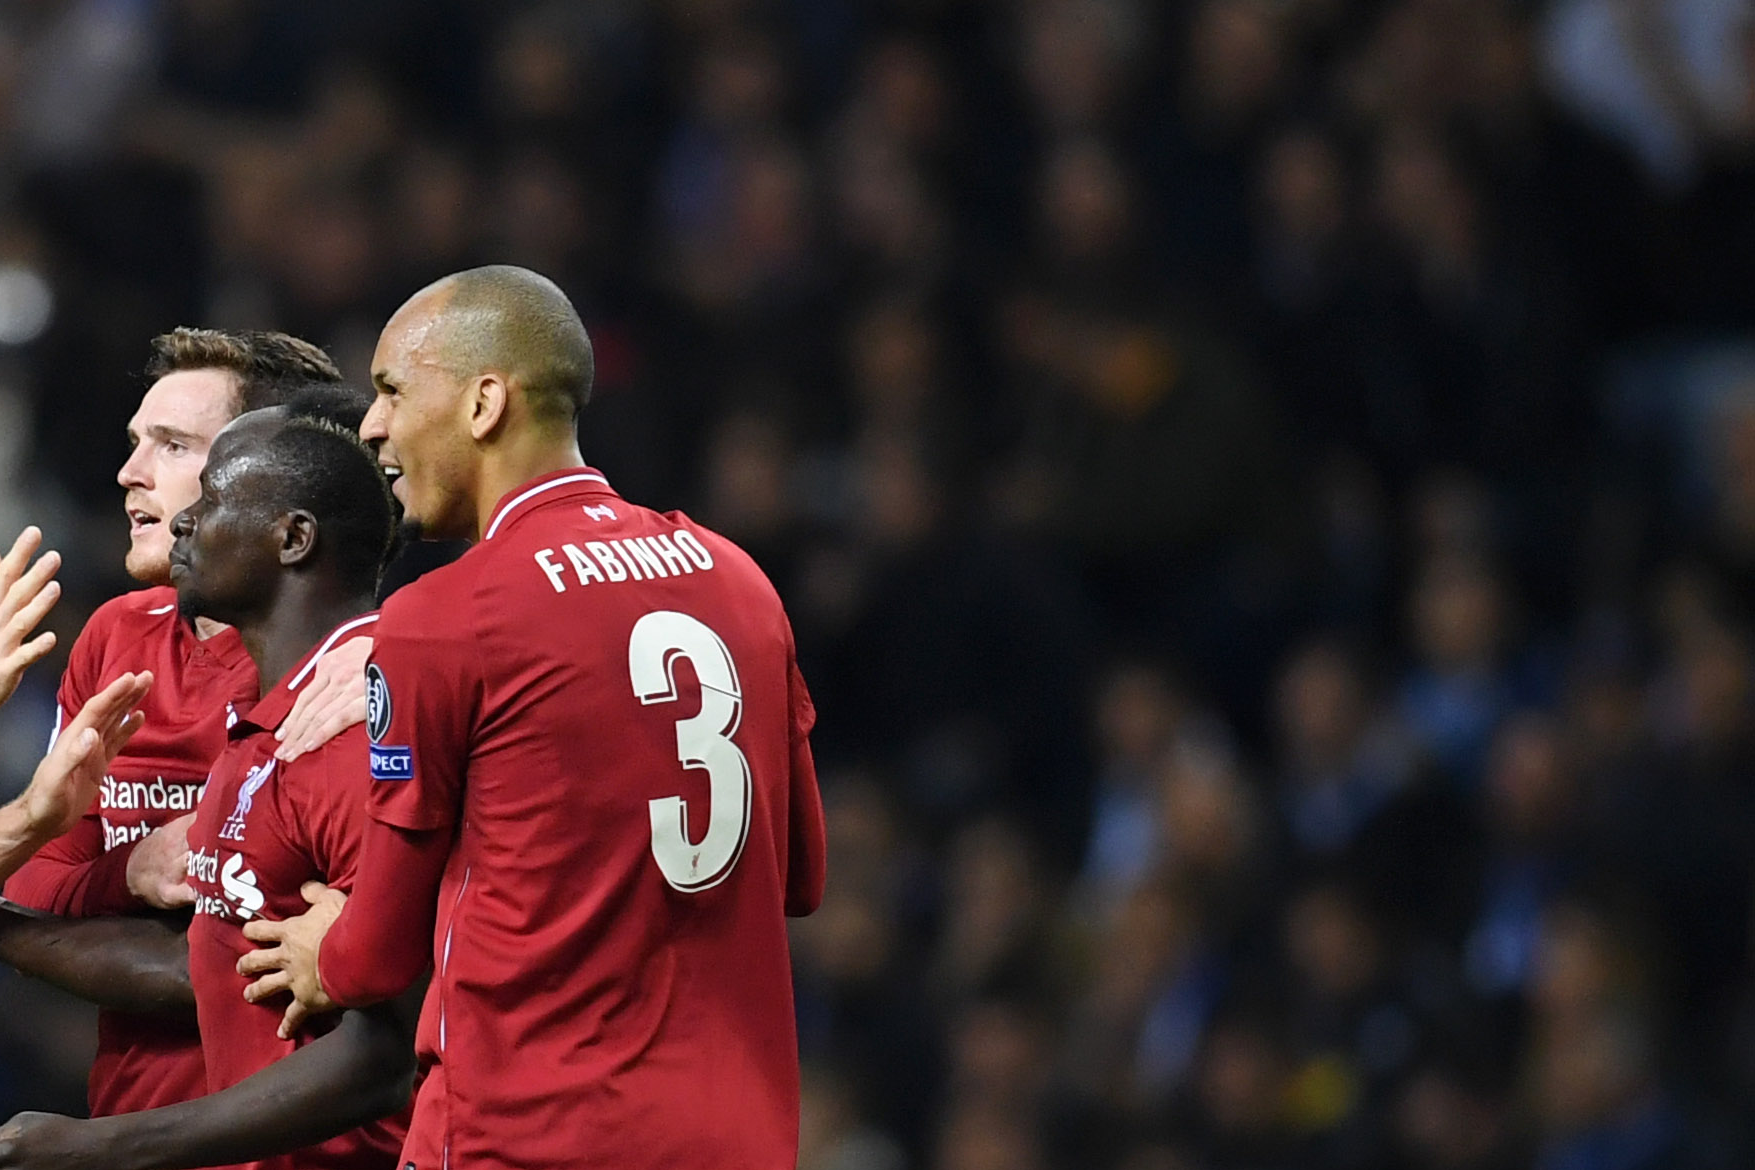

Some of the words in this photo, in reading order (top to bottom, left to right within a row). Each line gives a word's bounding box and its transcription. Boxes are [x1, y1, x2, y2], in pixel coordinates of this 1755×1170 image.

[534, 529, 714, 593] FABINHO
[370, 753, 411, 771] PECT
[628, 610, 753, 893] 3
